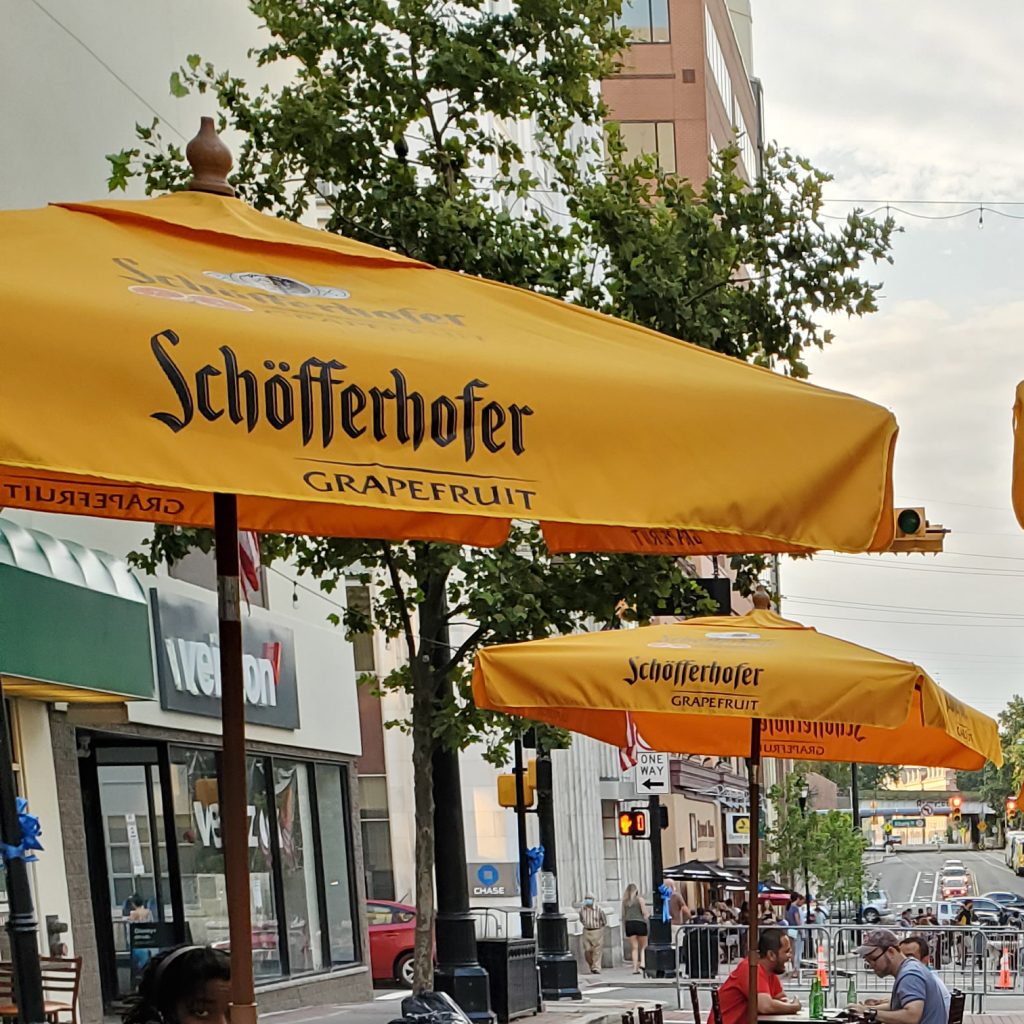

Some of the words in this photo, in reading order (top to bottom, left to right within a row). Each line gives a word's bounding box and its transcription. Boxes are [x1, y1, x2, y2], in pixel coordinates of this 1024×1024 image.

[150, 329, 534, 462] Schöfferhofer
[303, 471, 537, 510] GRAPEFRUIT
[623, 656, 764, 690] Schöfferhofer
[671, 695, 759, 711] GRAPEFRUIT
[641, 754, 664, 765] ONE
[641, 766, 664, 776] WAY
[473, 886, 505, 895] CHASE
